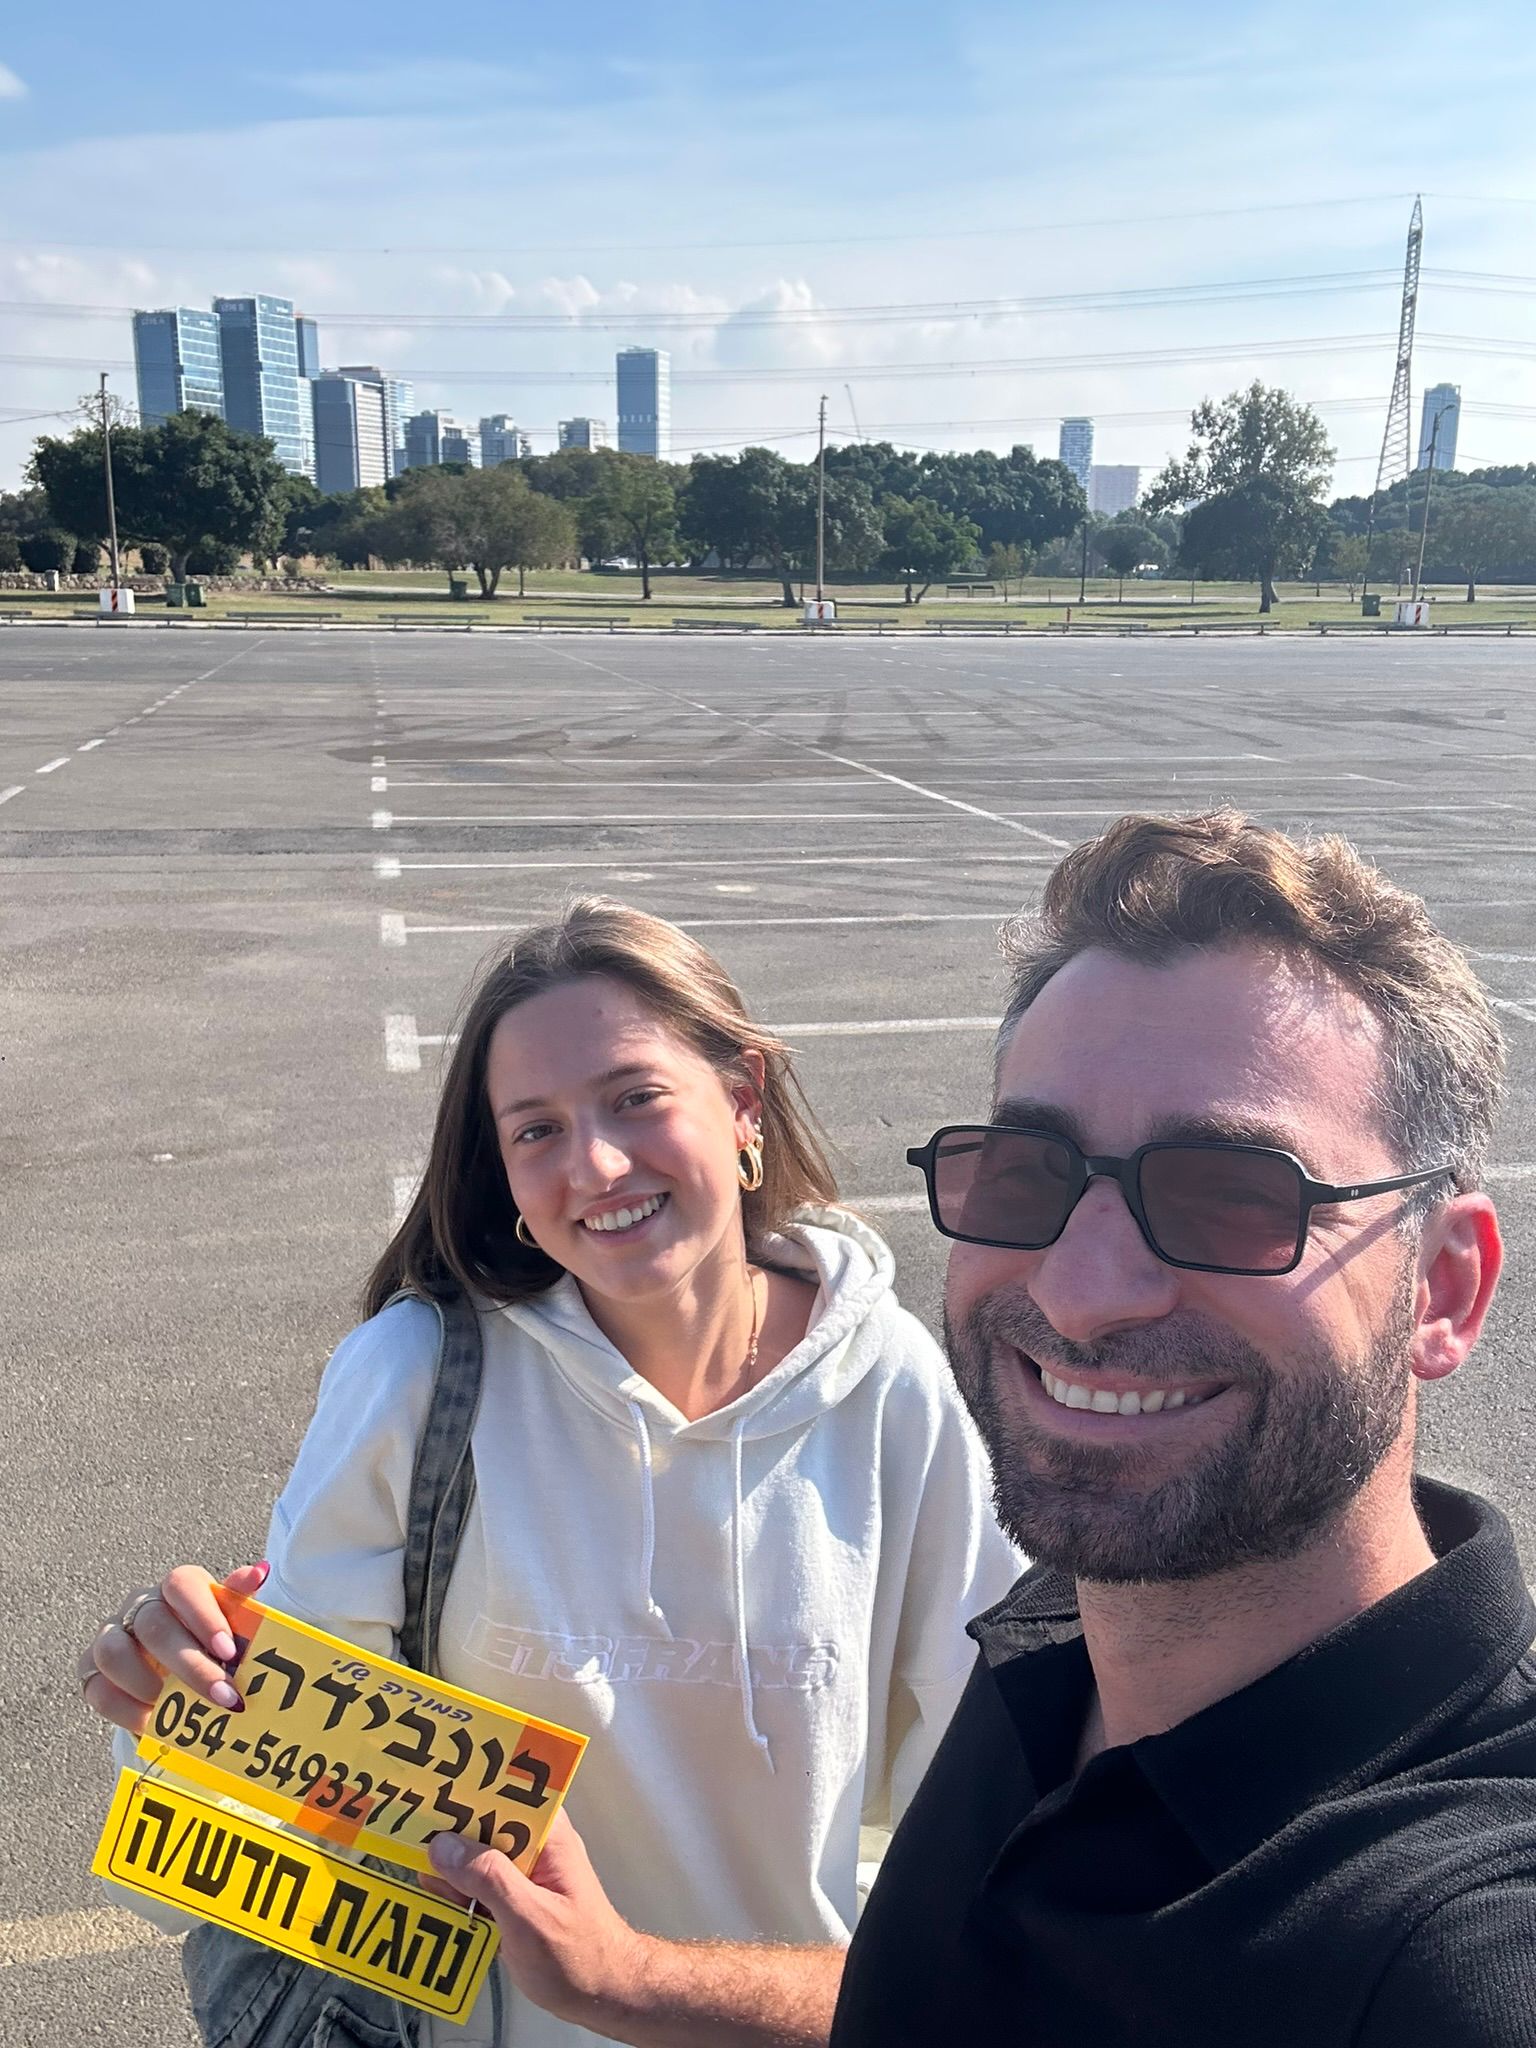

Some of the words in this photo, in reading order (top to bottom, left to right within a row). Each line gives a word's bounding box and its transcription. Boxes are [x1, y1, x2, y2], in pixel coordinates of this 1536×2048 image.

[245, 1647, 550, 1809] בונבידה
[331, 1659, 371, 1681] שלי
[378, 1681, 474, 1722] המורה
[154, 1691, 425, 1835] 054-5493277
[124, 1797, 311, 1930] חדש/ה
[310, 1879, 475, 1997] נהג/ת
